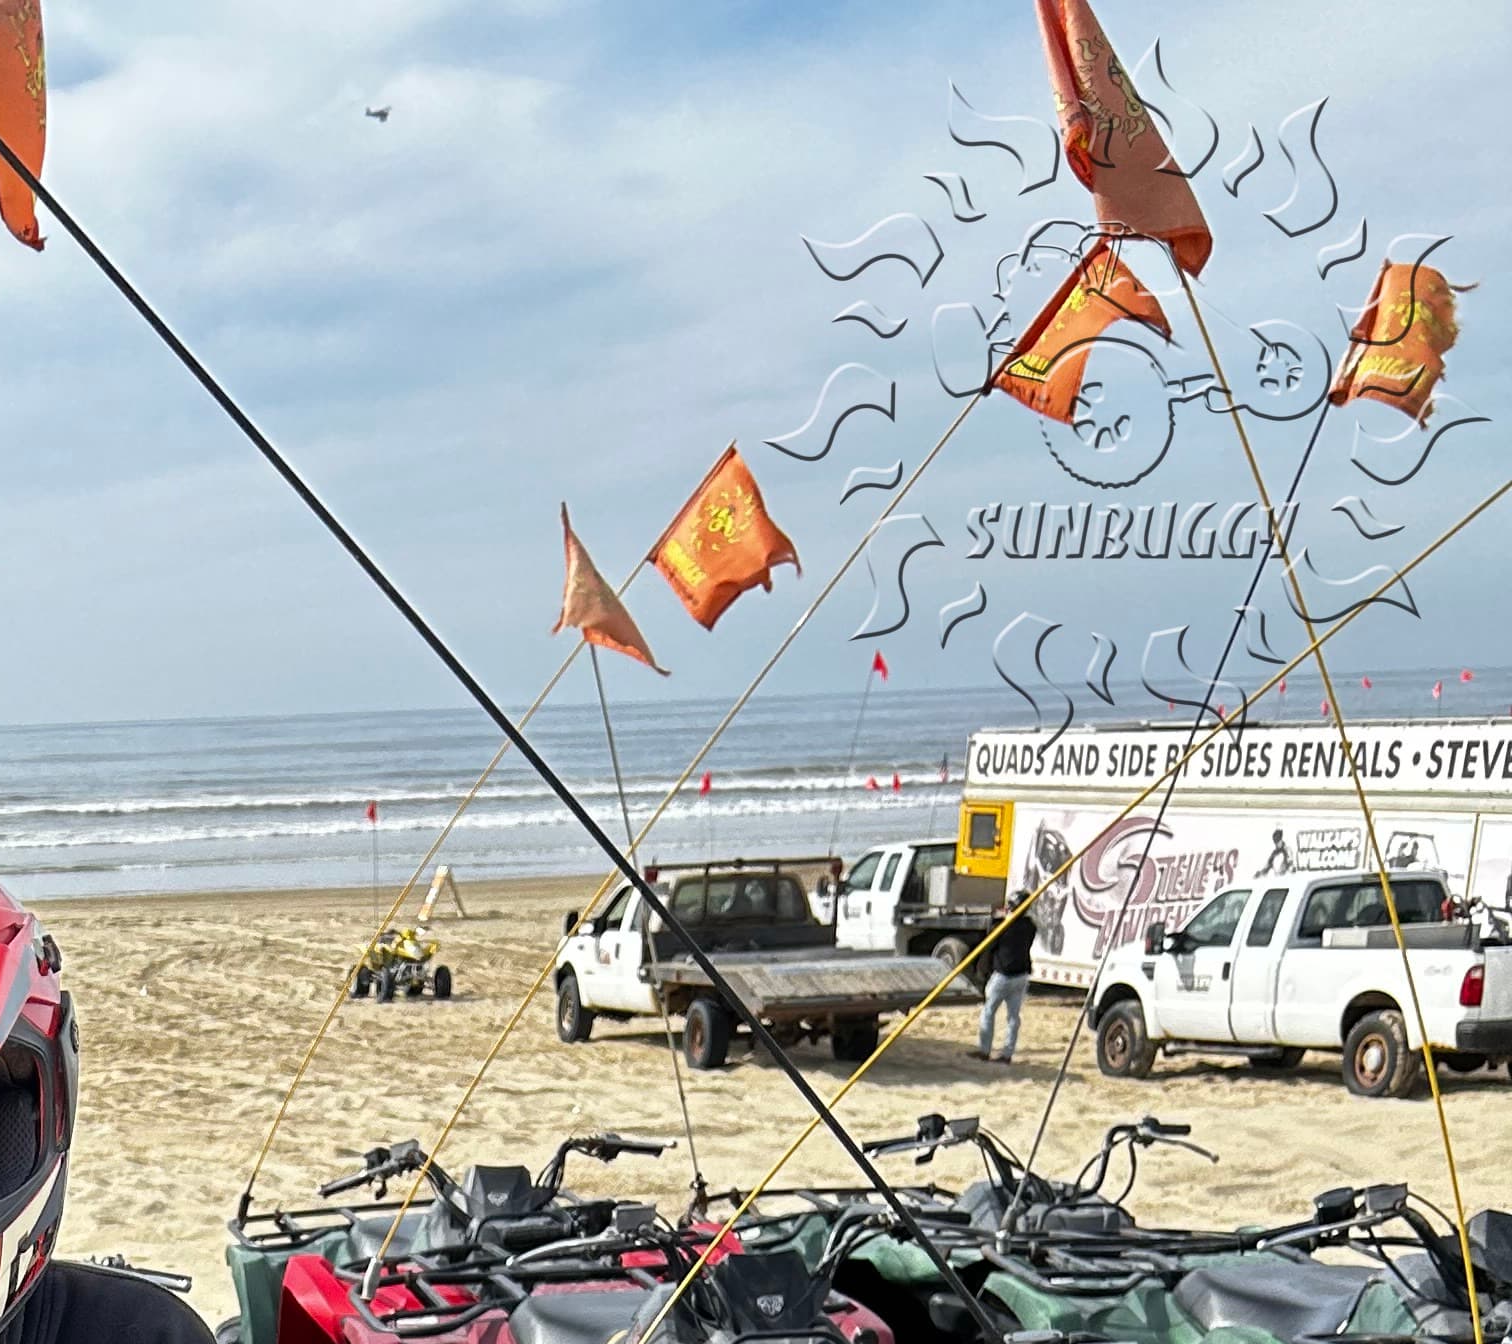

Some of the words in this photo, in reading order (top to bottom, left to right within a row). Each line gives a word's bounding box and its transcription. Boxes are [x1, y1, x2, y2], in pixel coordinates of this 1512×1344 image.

[976, 743, 1045, 777] QUADS
[1051, 744, 1099, 777] AND
[1106, 744, 1157, 777] SIDE
[1201, 742, 1273, 777] SIDES
[1280, 740, 1403, 779] RENTALS
